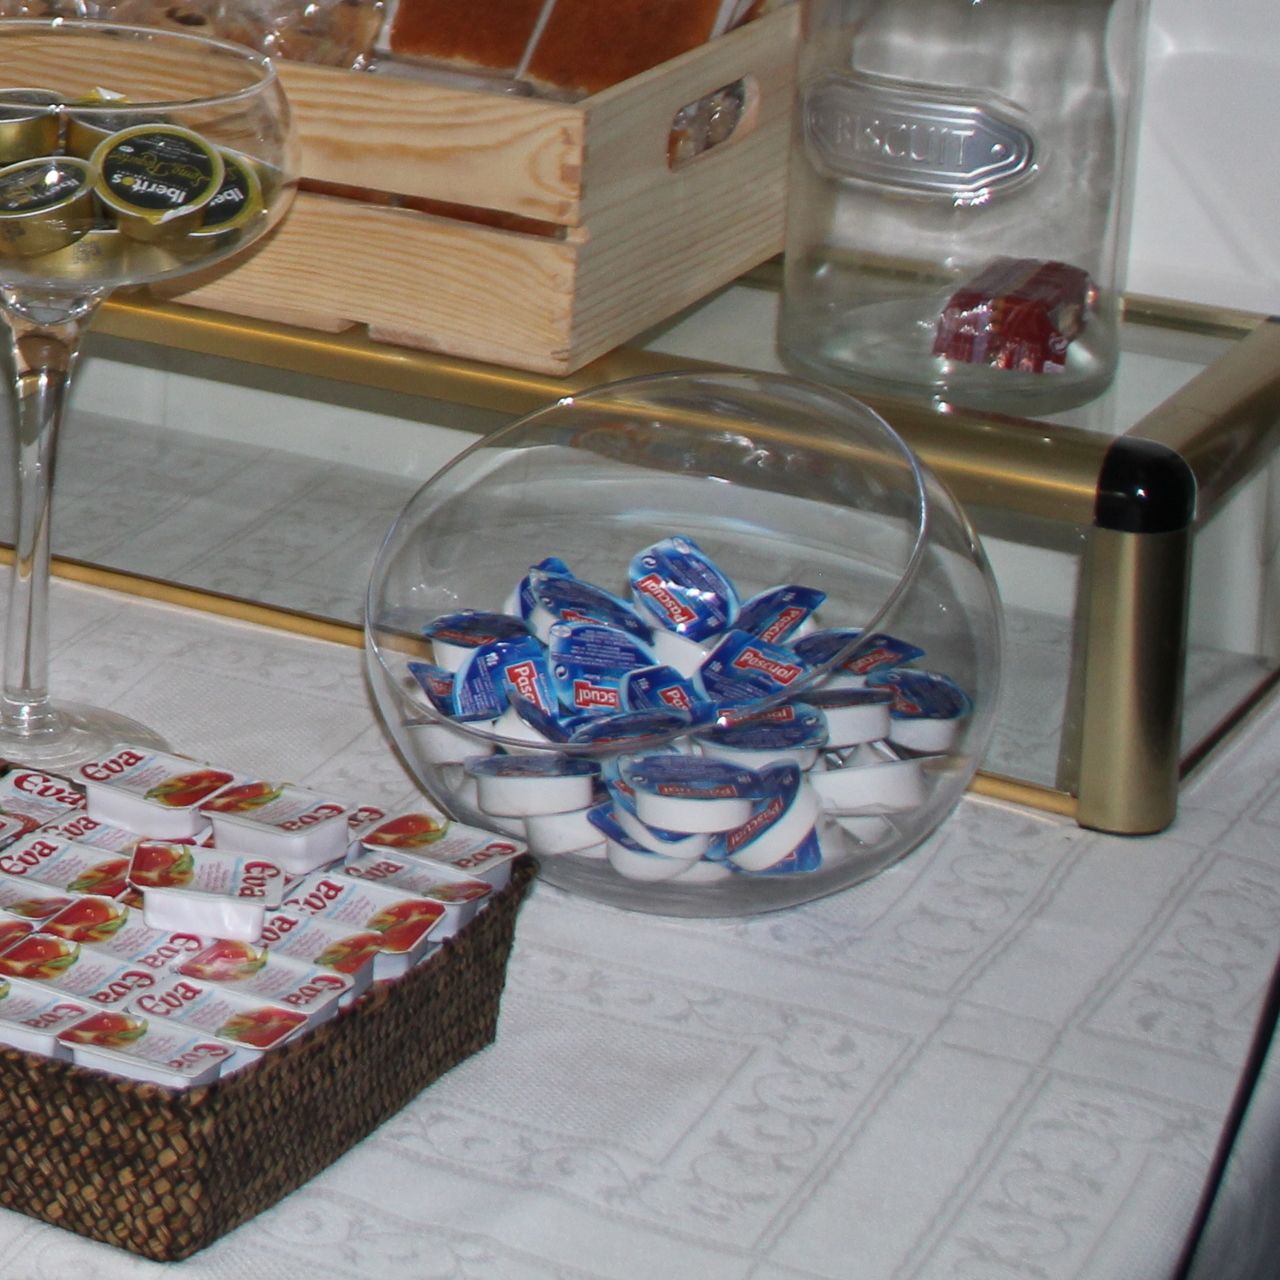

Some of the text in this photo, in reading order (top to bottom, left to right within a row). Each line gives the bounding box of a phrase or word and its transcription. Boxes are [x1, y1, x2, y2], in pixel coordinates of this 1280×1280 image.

[112, 174, 187, 204] Iberitos
[642, 581, 689, 624] Pascual
[761, 610, 800, 642] Pascu
[739, 651, 795, 683] Pascual
[514, 666, 536, 706] Pasc
[577, 688, 618, 705] scual
[80, 750, 145, 782] Eva
[14, 773, 87, 807] Eva
[277, 804, 345, 832] Eva
[348, 806, 385, 828] Ev
[729, 801, 781, 846] Pascual
[452, 842, 517, 868] Eva
[239, 861, 282, 898] Eva
[260, 915, 299, 948] va
[138, 932, 204, 968] Eva
[90, 970, 156, 1005] Eva
[137, 981, 203, 1016] Eva
[281, 974, 347, 1008] Eva
[22, 1003, 88, 1028] Eva
[167, 1043, 231, 1069] Eva
